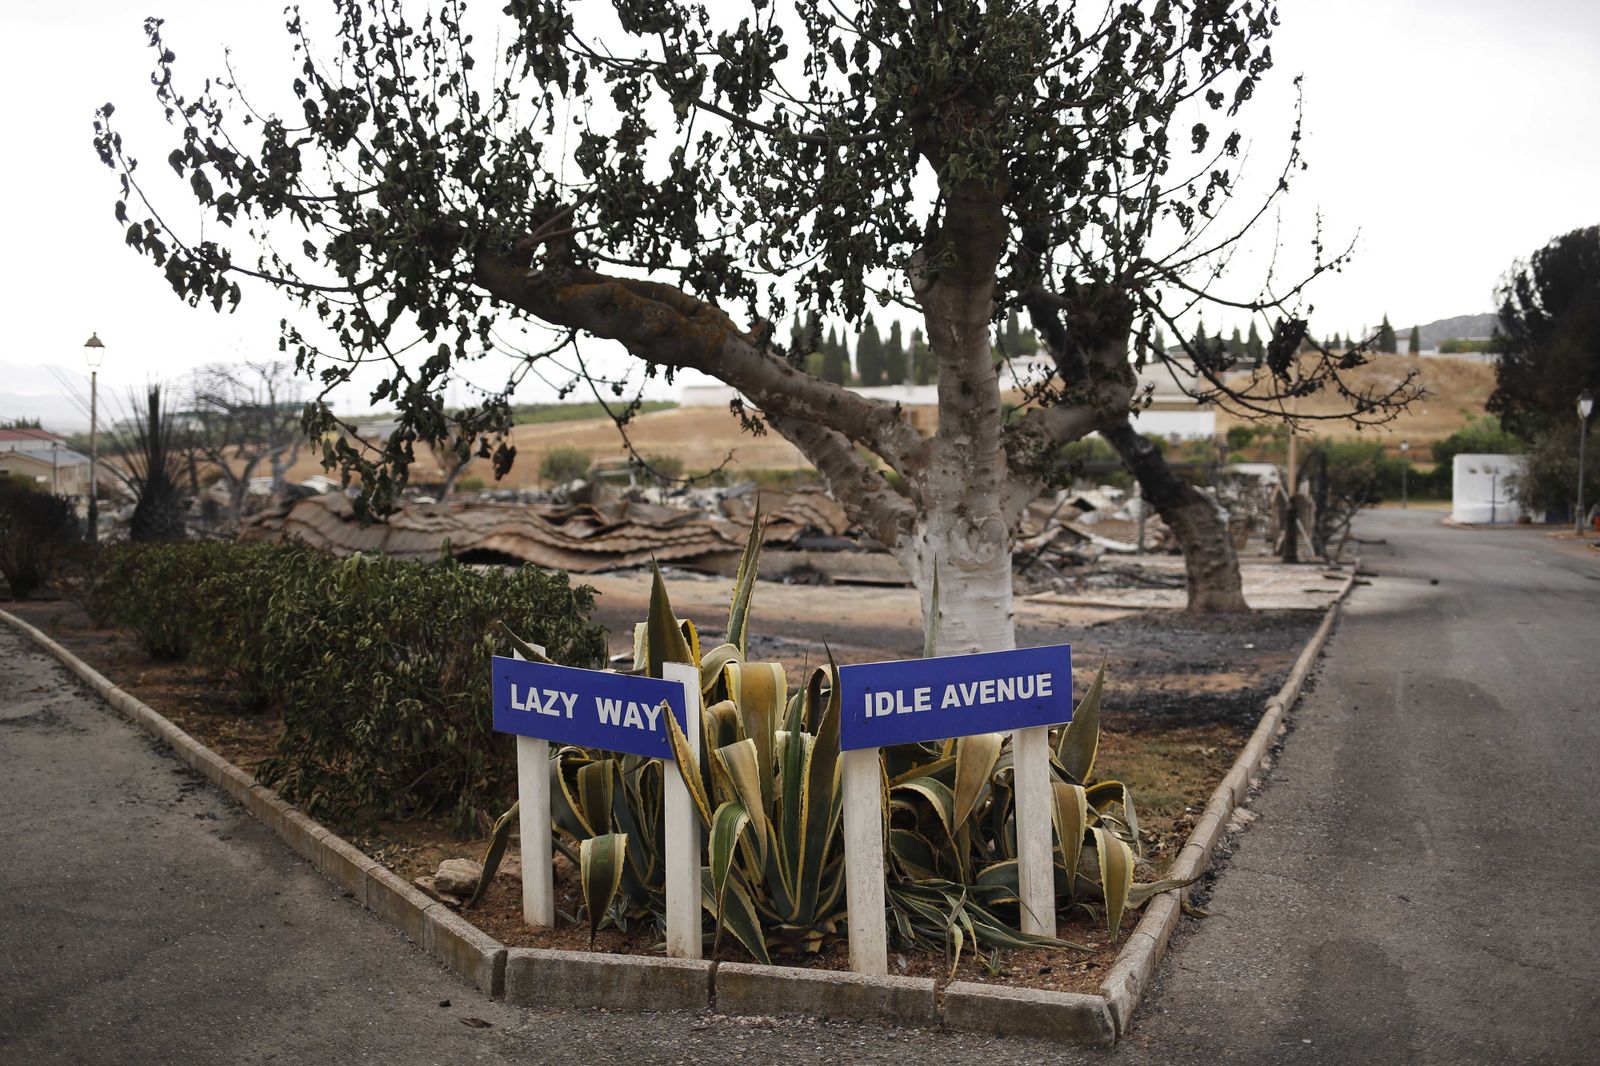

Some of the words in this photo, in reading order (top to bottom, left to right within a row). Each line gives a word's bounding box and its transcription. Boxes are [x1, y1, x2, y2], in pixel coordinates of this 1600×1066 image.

[511, 683, 579, 719] LAZY
[595, 696, 663, 732] WAY
[864, 687, 932, 718] IDLE
[940, 673, 1053, 709] AVENUE
